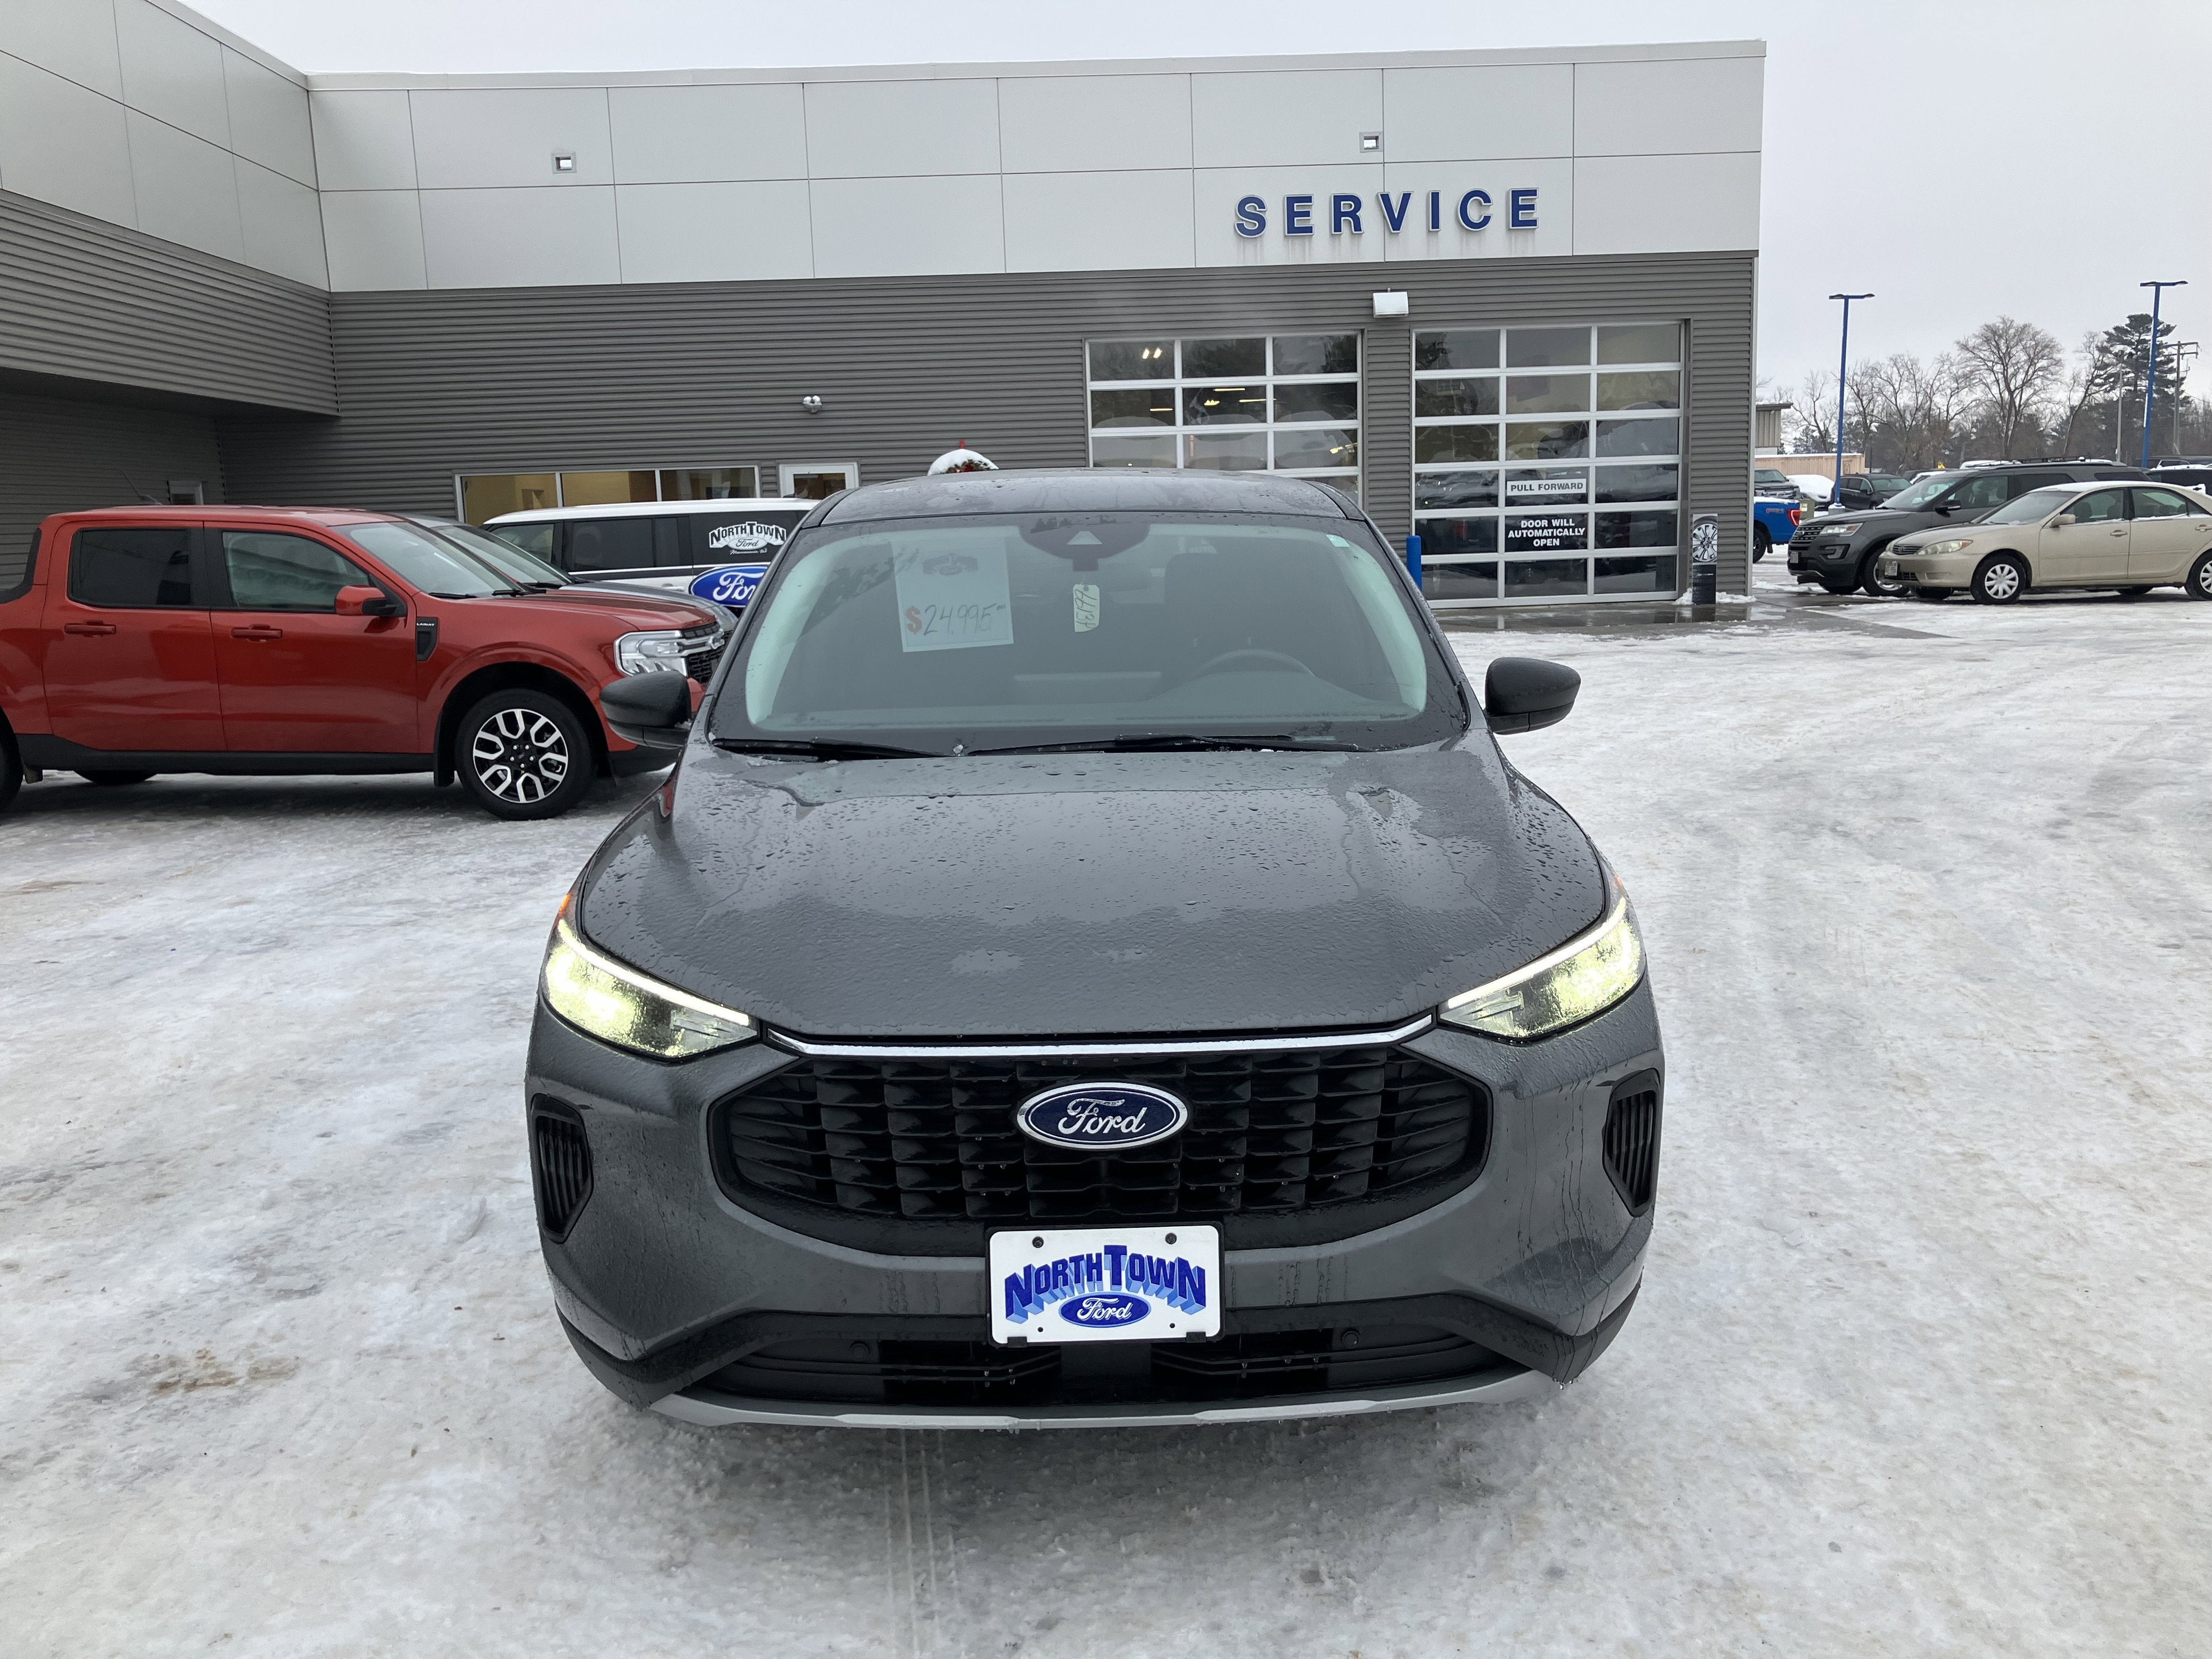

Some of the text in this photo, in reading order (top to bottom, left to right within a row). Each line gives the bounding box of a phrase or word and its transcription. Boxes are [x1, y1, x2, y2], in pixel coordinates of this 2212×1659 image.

[1234, 187, 1539, 238] SERVICE
[1538, 482, 1583, 490] FORWARD
[1521, 518, 1575, 528] DOOR WILL
[1508, 528, 1585, 538] AUTOMATICALLY
[736, 538, 759, 547] Ford
[1533, 538, 1560, 546] OPEN
[1058, 1098, 1147, 1134] Ford
[1077, 1297, 1133, 1321] Ford
